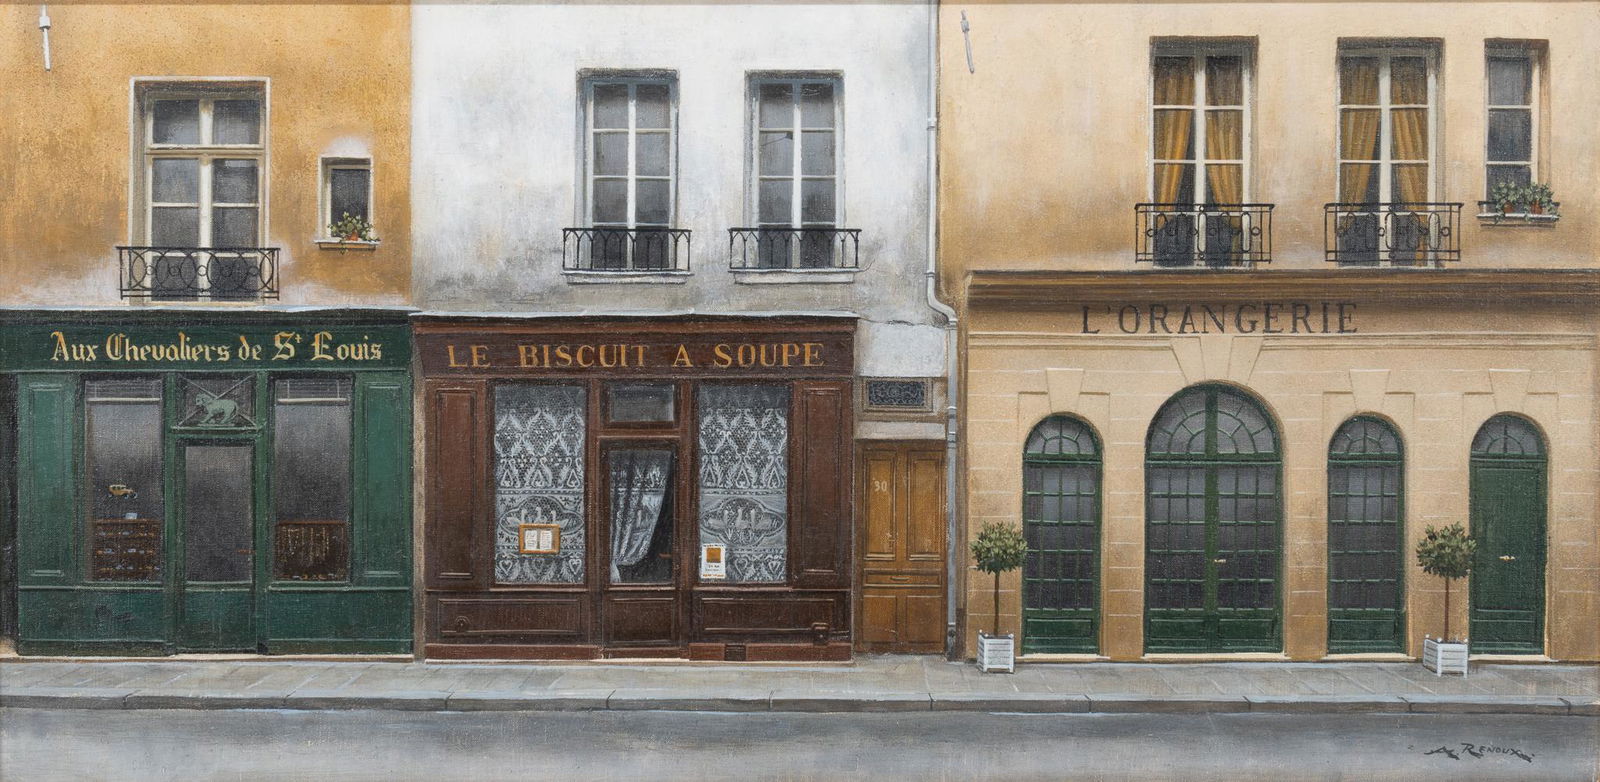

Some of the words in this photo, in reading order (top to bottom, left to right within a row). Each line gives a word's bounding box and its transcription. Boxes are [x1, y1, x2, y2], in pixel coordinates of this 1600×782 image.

[1080, 301, 1359, 335] L'ORANGERIE
[50, 331, 97, 362] Aux
[106, 331, 230, 362] Chevaliers
[238, 334, 263, 361] de
[310, 331, 383, 361] Louis
[447, 344, 491, 368] LE
[518, 344, 649, 368] BISCUIT
[672, 344, 695, 367] A
[712, 342, 825, 368] SOUPE
[874, 480, 888, 492] 30
